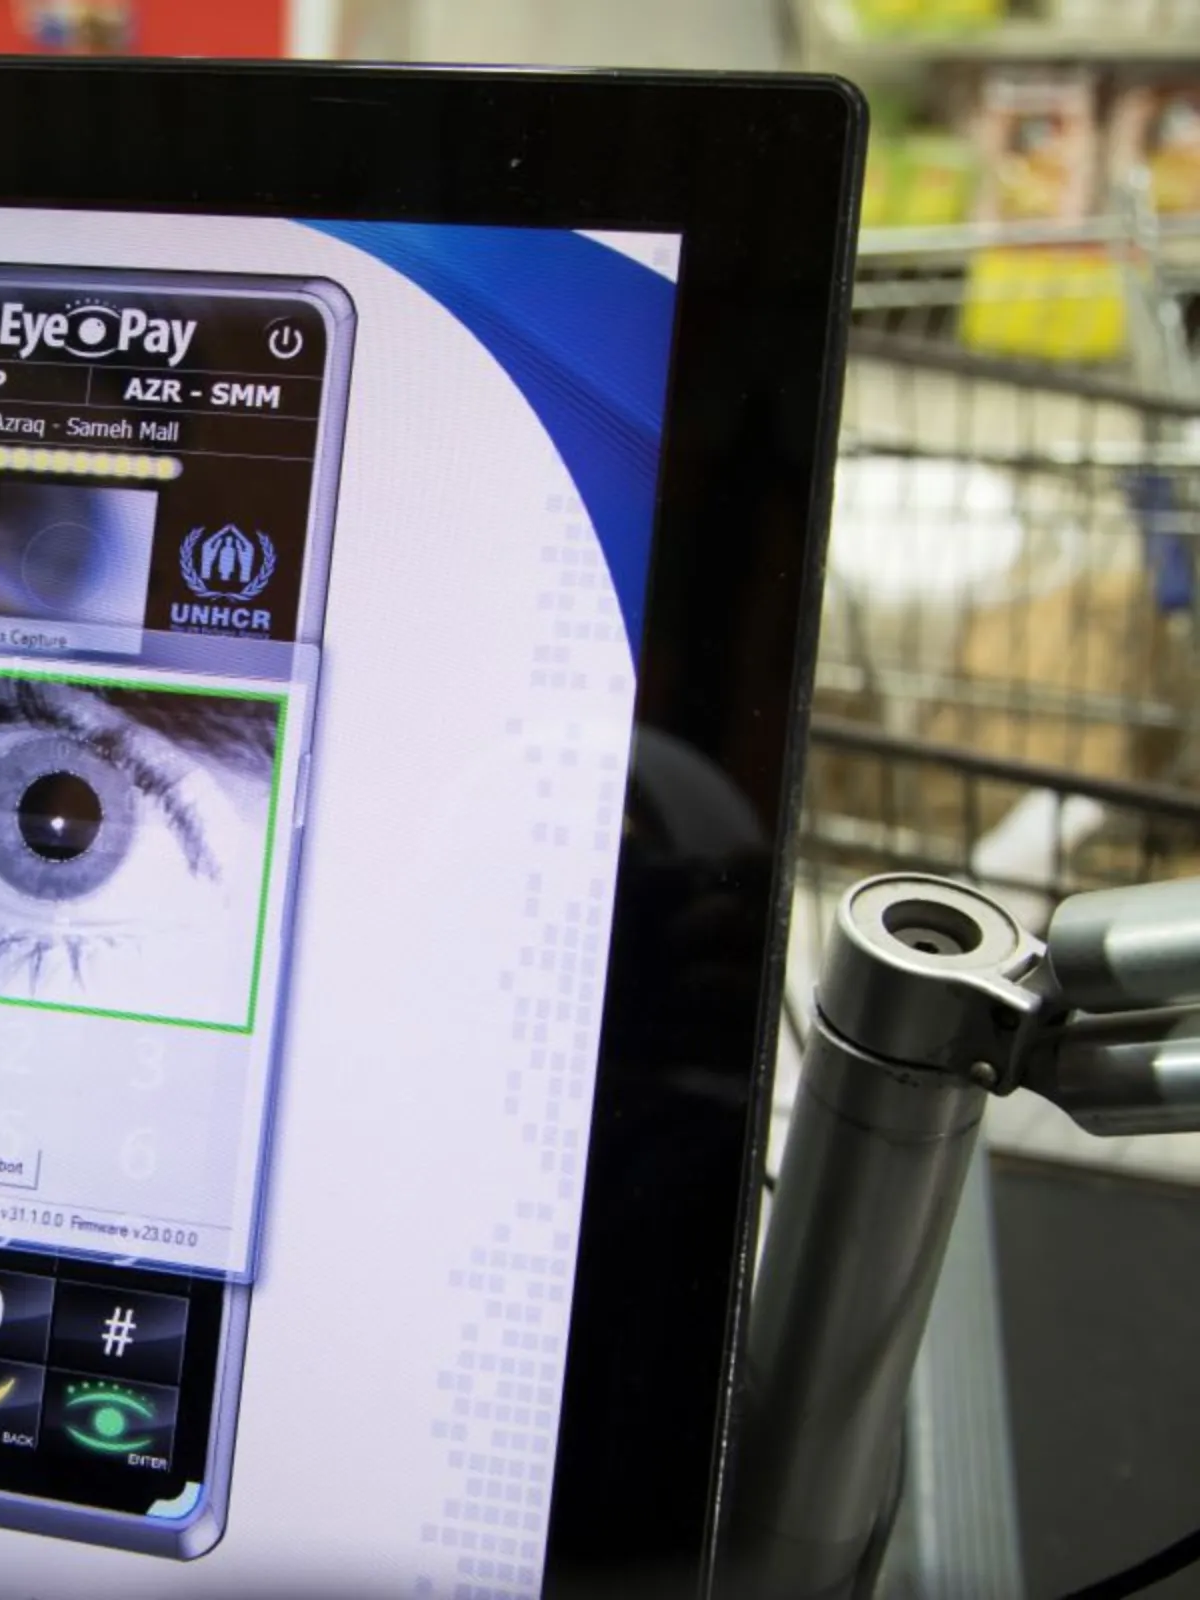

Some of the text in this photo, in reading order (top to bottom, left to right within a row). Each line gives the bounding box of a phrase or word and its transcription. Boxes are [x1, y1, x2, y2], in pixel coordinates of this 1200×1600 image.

[117, 308, 197, 367] Pay
[124, 377, 182, 402] AZR
[210, 382, 281, 408] SMM
[66, 417, 132, 439] Sameh
[139, 421, 179, 442] Mall
[171, 603, 271, 629] UNHCR
[10, 630, 68, 649] Capture
[70, 1215, 129, 1238] Firmware
[101, 1306, 137, 1357] #
[2, 1431, 34, 1448] BACK
[128, 1453, 168, 1470] ENTER
